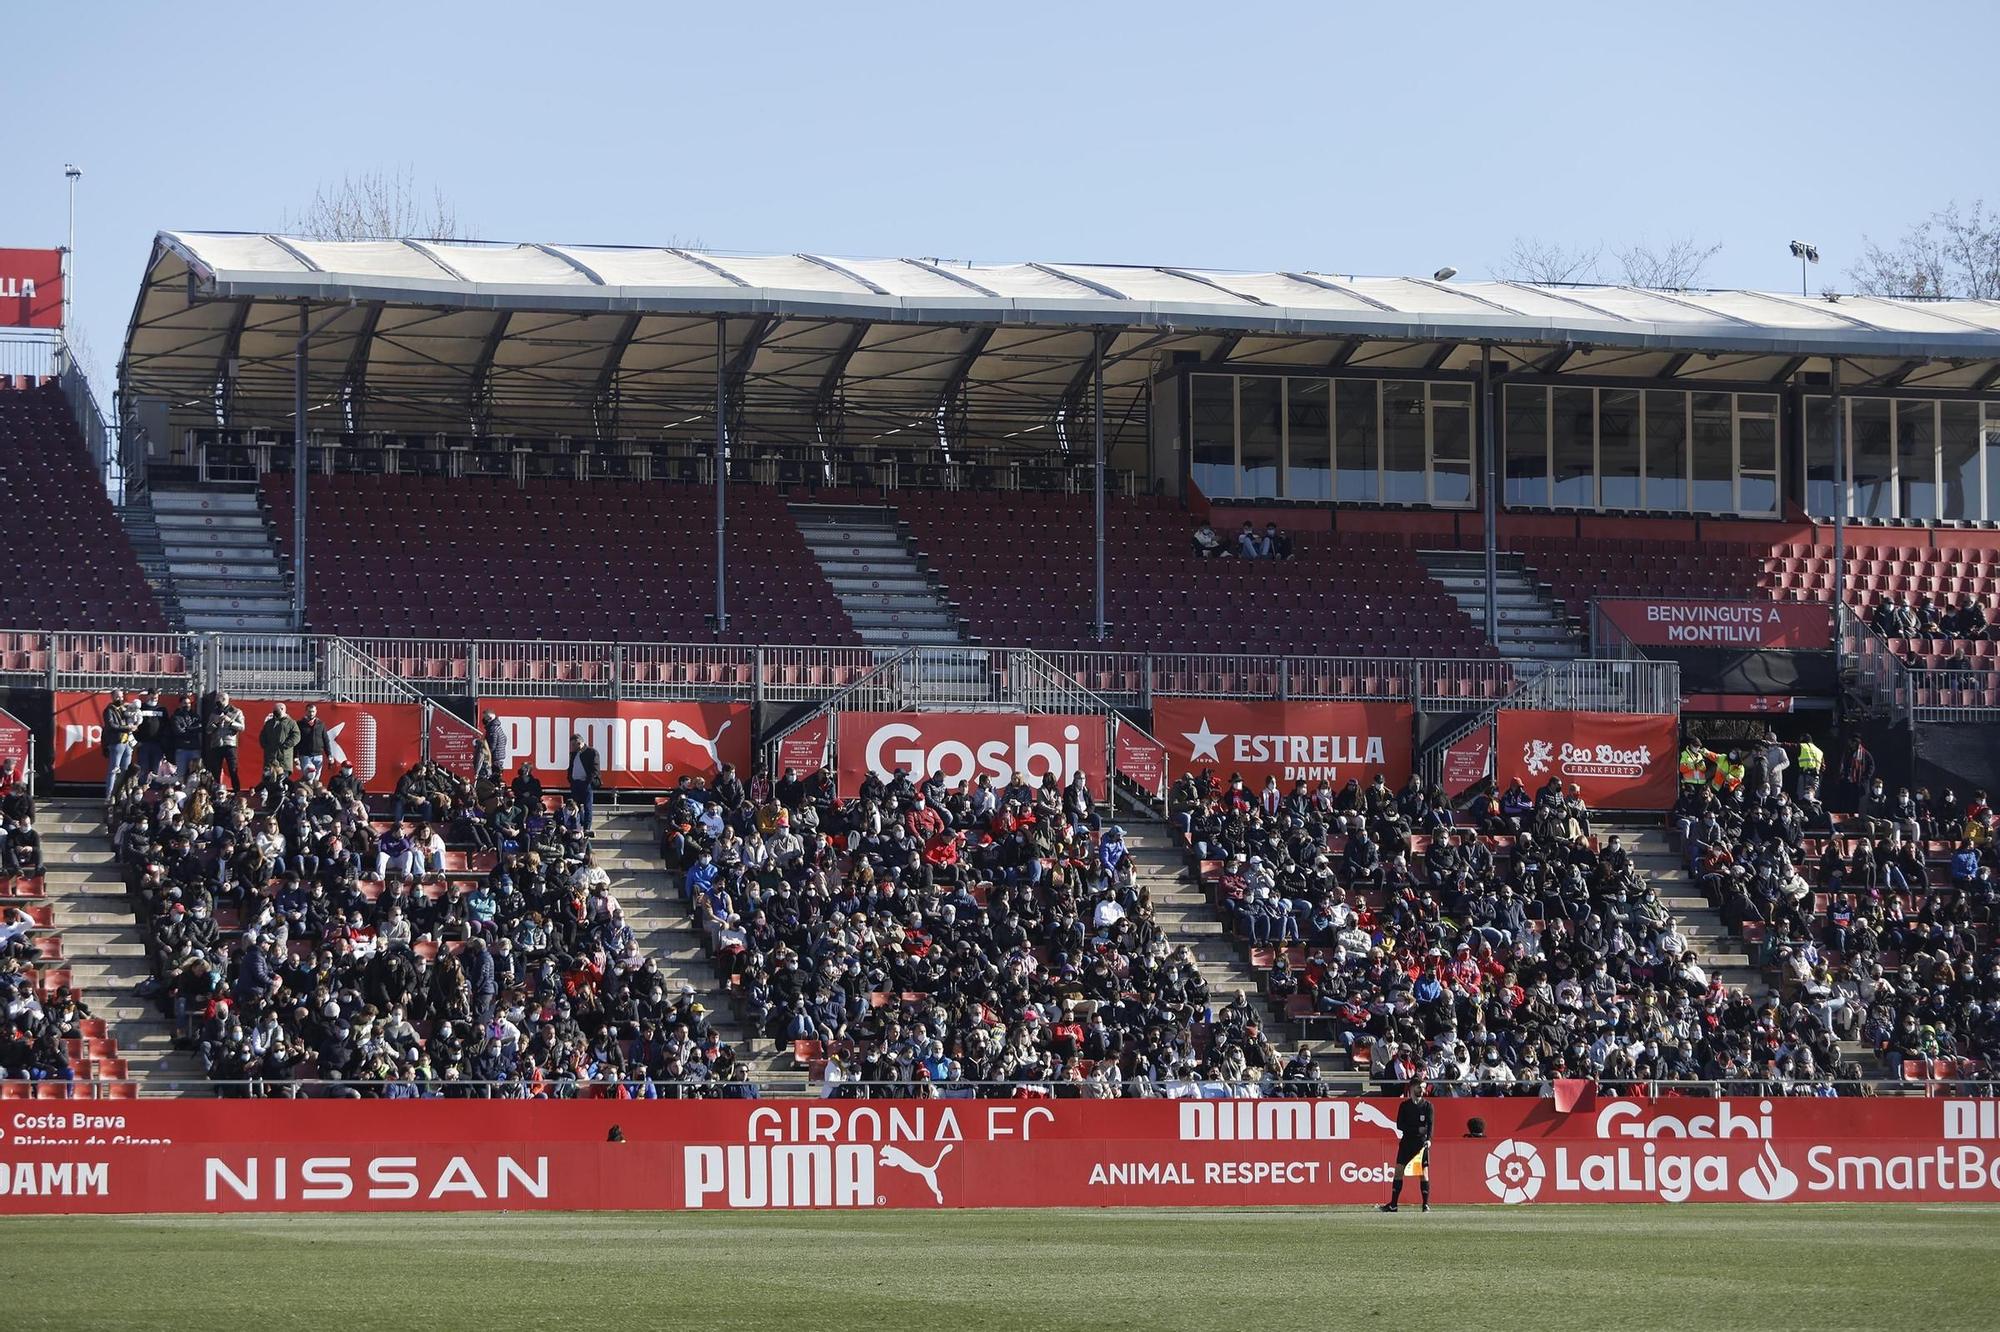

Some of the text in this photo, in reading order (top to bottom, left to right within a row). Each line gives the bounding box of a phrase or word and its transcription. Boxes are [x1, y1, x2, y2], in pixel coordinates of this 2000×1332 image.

[1647, 606, 1781, 623] BENVINGUTS A
[1668, 625, 1761, 642] MONTILIVI
[498, 716, 664, 772] PUMA
[865, 723, 1080, 791] Gosbi
[1233, 735, 1385, 764] ESTRELLA
[1558, 742, 1652, 765] Leo Boeck
[1284, 767, 1337, 781] DAMM
[1571, 765, 1635, 775] FRANKFURTS
[13, 1113, 126, 1129] Costa Brava
[748, 1107, 963, 1142] GIRONA
[205, 1156, 549, 1201] NISSAN
[684, 1144, 876, 1208] PUMA
[1088, 1161, 1320, 1185] ANIMAL RESPECT
[1555, 1142, 1729, 1202] LaLiga
